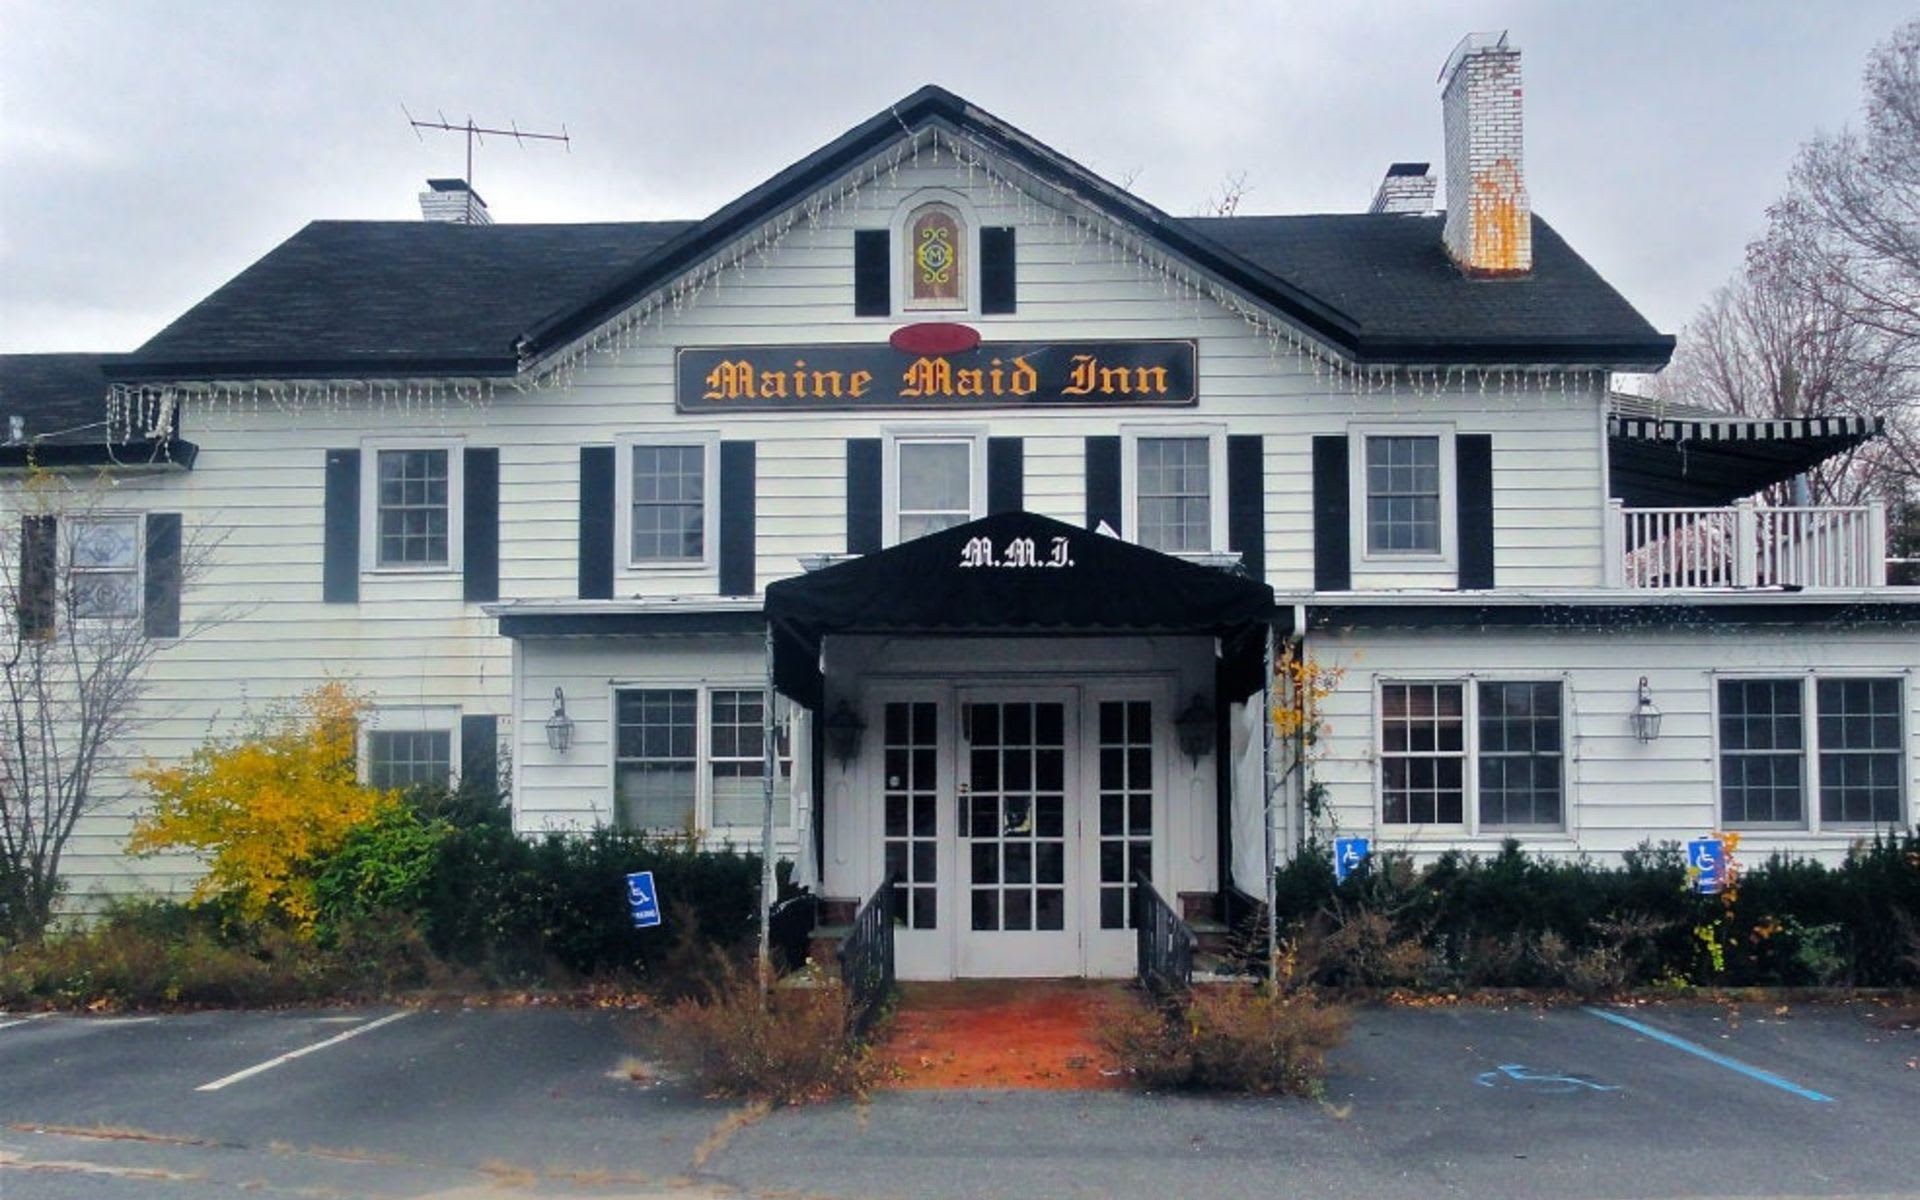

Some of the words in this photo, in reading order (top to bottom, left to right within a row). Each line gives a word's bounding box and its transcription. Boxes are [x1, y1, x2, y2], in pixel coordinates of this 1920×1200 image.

[703, 359, 872, 399] Maine
[901, 356, 1037, 397] Maid
[1062, 354, 1168, 394] Inn
[959, 536, 1075, 567] M.M.I.
